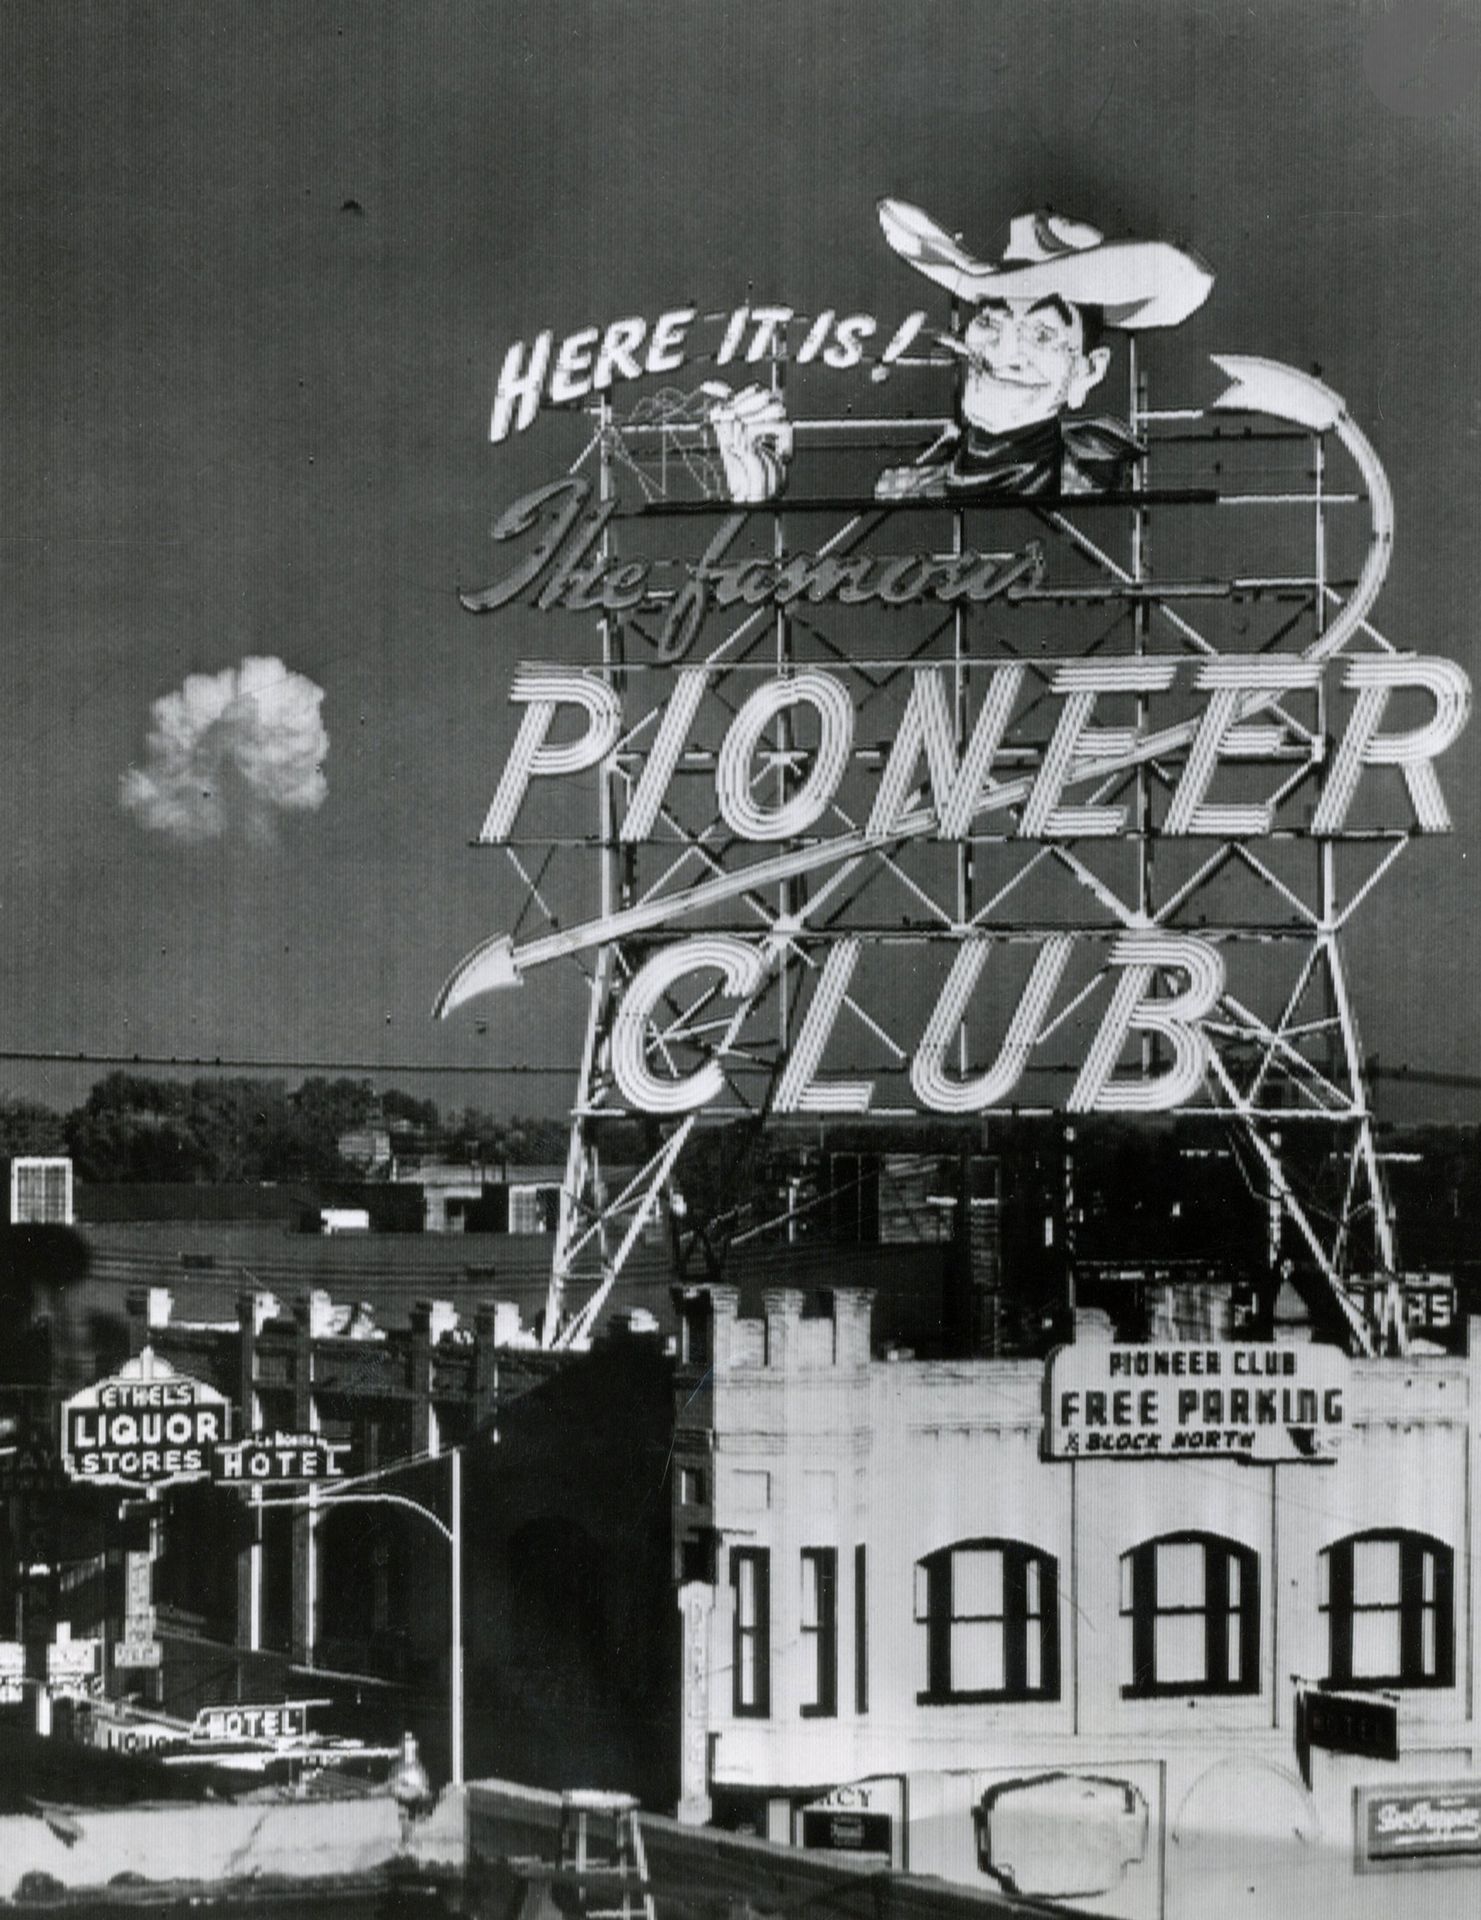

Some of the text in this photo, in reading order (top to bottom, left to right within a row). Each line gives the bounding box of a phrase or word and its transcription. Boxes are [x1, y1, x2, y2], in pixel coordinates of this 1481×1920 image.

[489, 308, 697, 442] HERE
[716, 305, 795, 365] IT
[459, 477, 1047, 667] The famous
[478, 655, 1472, 843] PIONEER
[610, 934, 1225, 1114] CLUB
[1109, 1351, 1298, 1377] PIONEER CLUB
[1061, 1388, 1344, 1427] FREE PARKING
[75, 1411, 219, 1448] LIQUOR
[1085, 1432, 1162, 1451] BLOCK
[1171, 1429, 1256, 1449] NORTH
[82, 1449, 202, 1474] STORES
[223, 1450, 344, 1477] HOTEL
